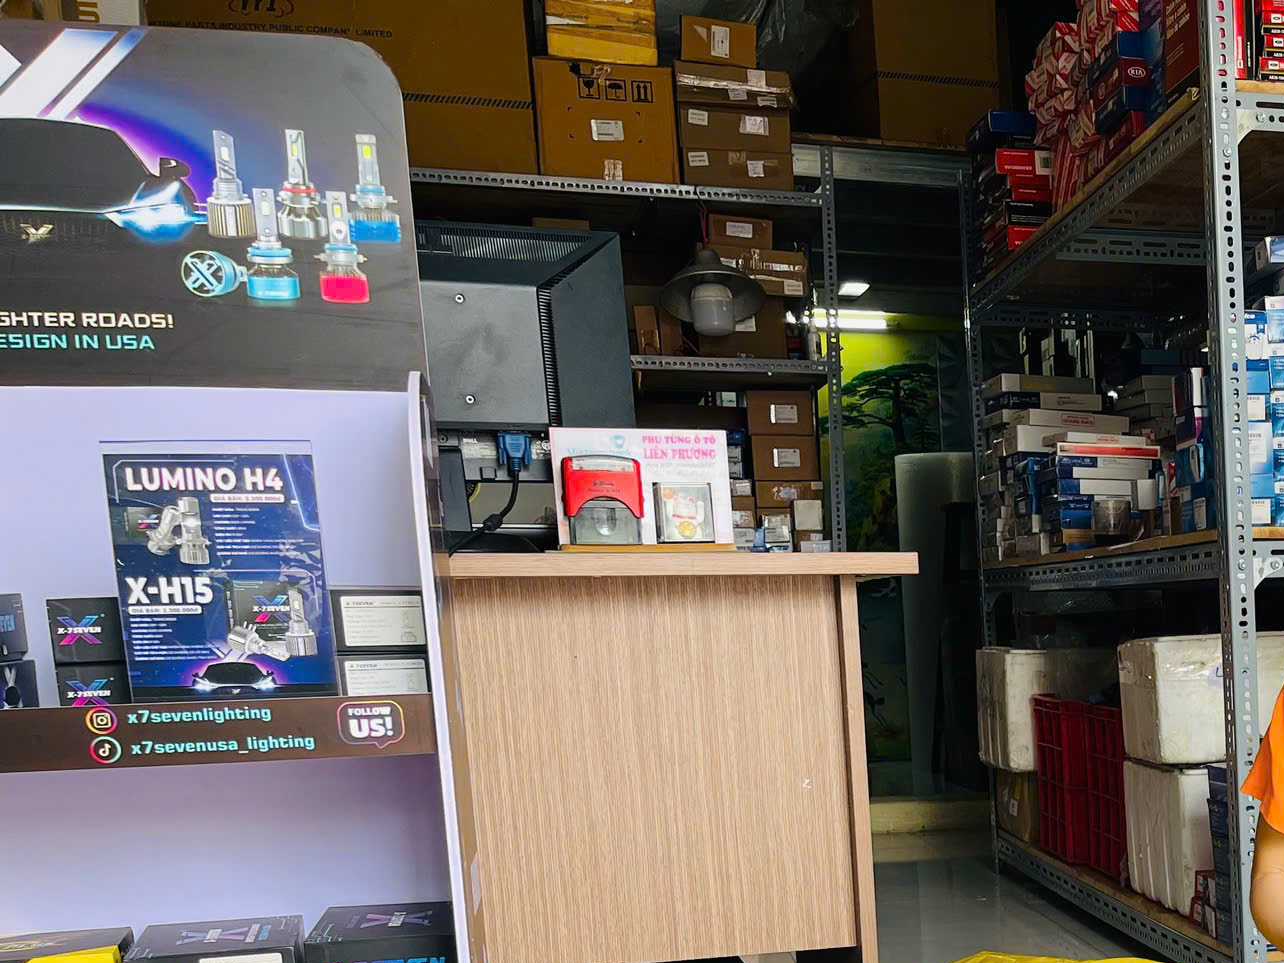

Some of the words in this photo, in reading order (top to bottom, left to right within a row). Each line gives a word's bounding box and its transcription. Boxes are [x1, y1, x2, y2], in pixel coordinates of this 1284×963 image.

[218, 22, 267, 32] INDUSTRY
[268, 24, 304, 33] PUBLIC
[355, 28, 393, 39] LIMITED
[1129, 67, 1145, 76] KIA
[81, 311, 175, 329] ROADS!
[74, 334, 99, 349] IN
[105, 334, 156, 351] USA
[124, 466, 238, 492] LUMINO
[243, 467, 285, 491] H4
[124, 576, 214, 605] X-H15
[56, 626, 102, 635] X-7SEVEN
[66, 689, 111, 699] X-7SEVEN
[127, 706, 272, 724] x7sevenlighting
[347, 706, 391, 717] FOLLOW
[348, 716, 394, 739] US!
[131, 734, 316, 756] x7sevenusa_lighting
